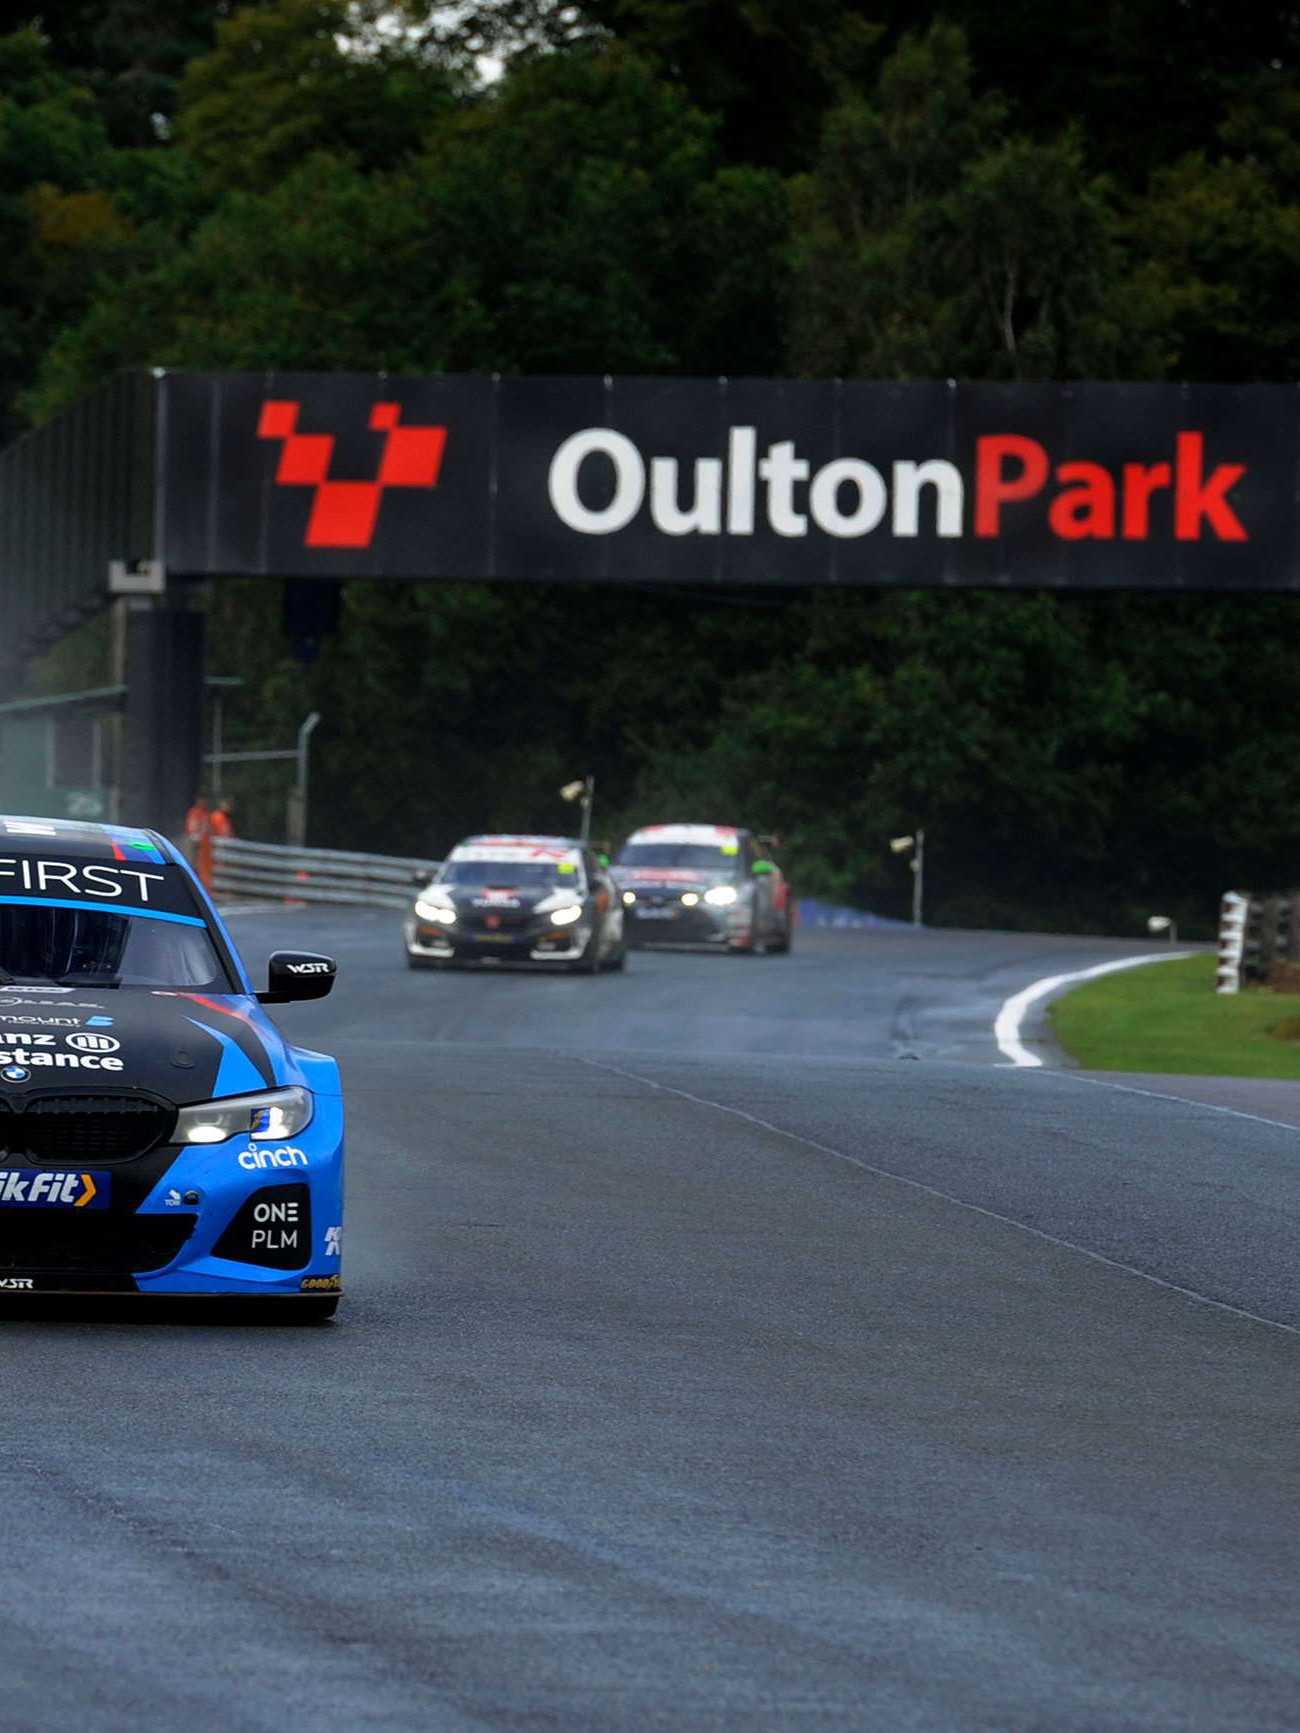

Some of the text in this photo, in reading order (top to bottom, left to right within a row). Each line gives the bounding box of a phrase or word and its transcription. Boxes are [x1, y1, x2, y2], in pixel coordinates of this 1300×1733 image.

[286, 962, 330, 974] WSR
[237, 1143, 308, 1170] cinch
[253, 1202, 299, 1222] ONE
[251, 1229, 298, 1249] PLM
